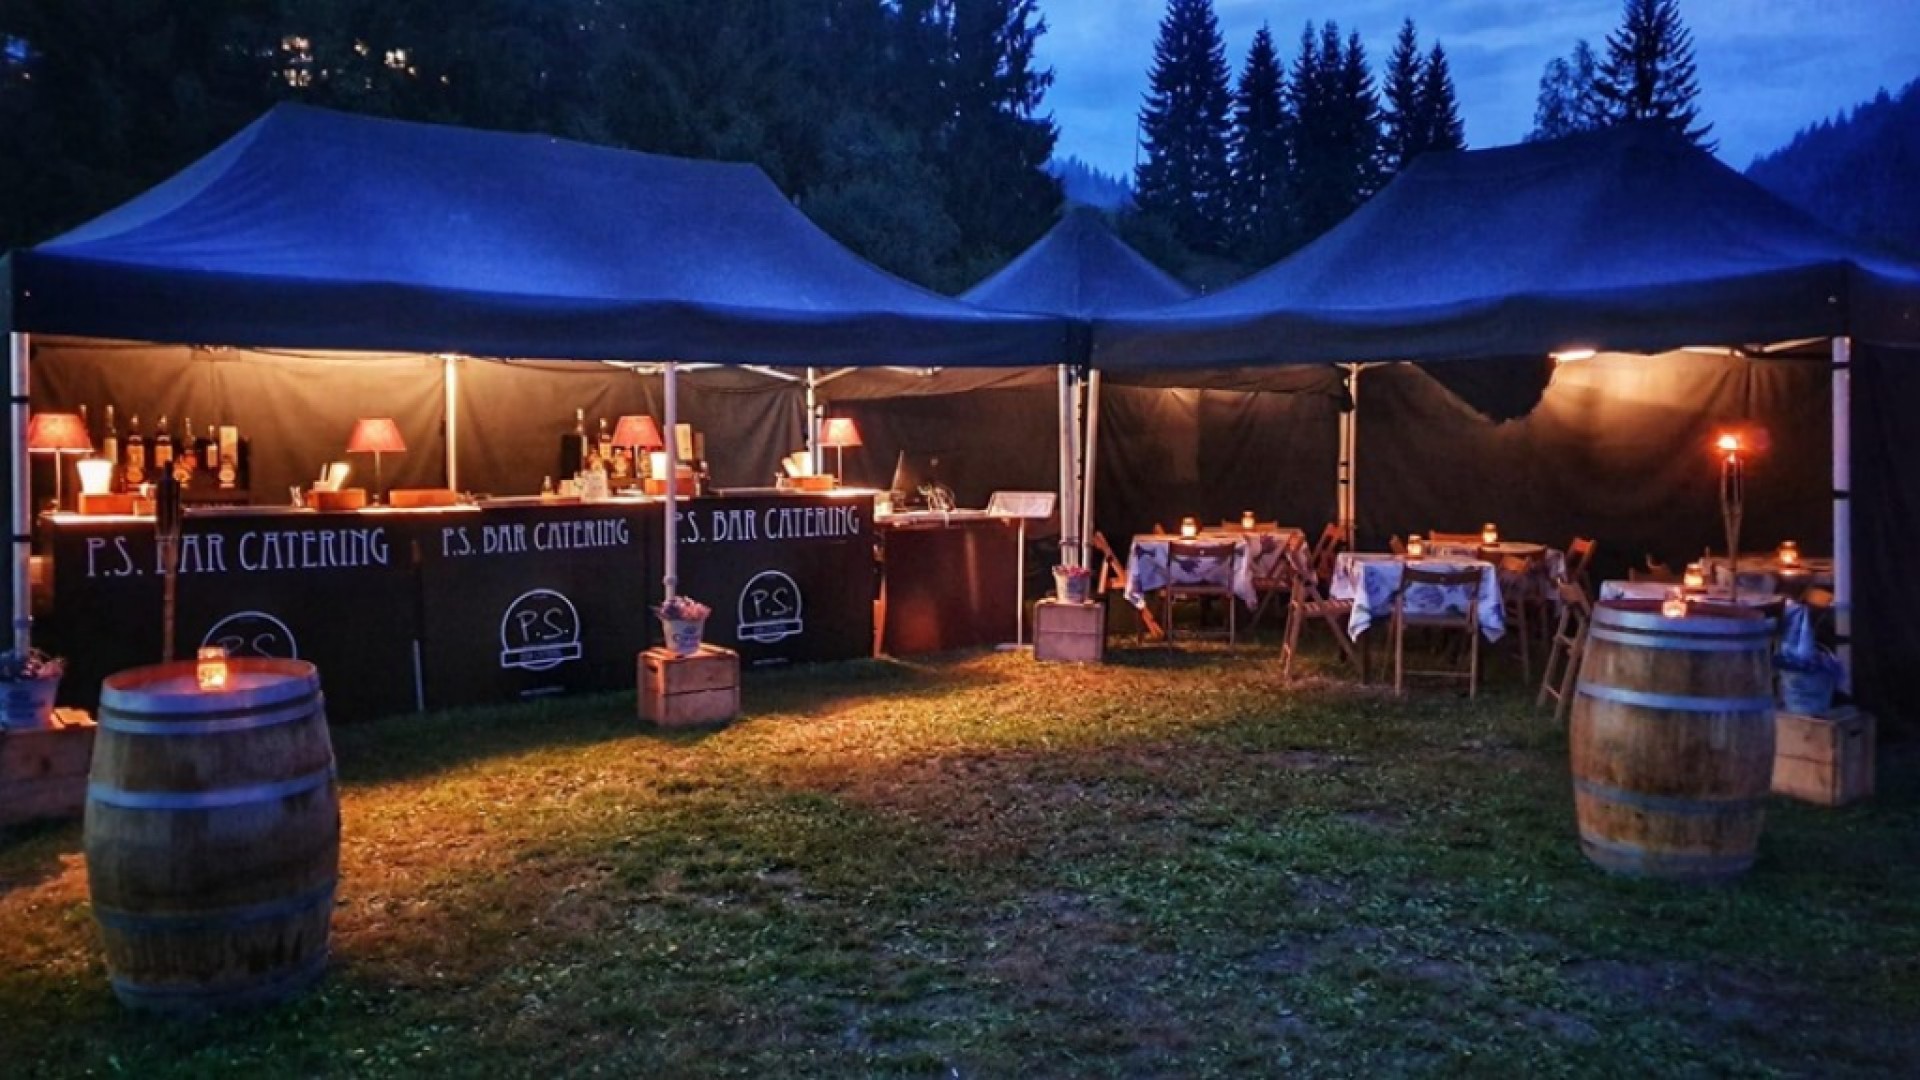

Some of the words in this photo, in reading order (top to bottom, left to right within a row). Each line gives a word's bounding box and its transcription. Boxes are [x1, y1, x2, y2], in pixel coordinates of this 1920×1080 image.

[442, 526, 477, 557] P.S.
[482, 524, 528, 554] BAR
[533, 517, 629, 550] CATERING
[712, 509, 758, 541] BAR
[764, 505, 860, 539] CATERING
[86, 535, 143, 577] P.S.
[239, 527, 389, 571] CATERING
[751, 587, 793, 617] P.S.
[516, 607, 569, 642] P.S.
